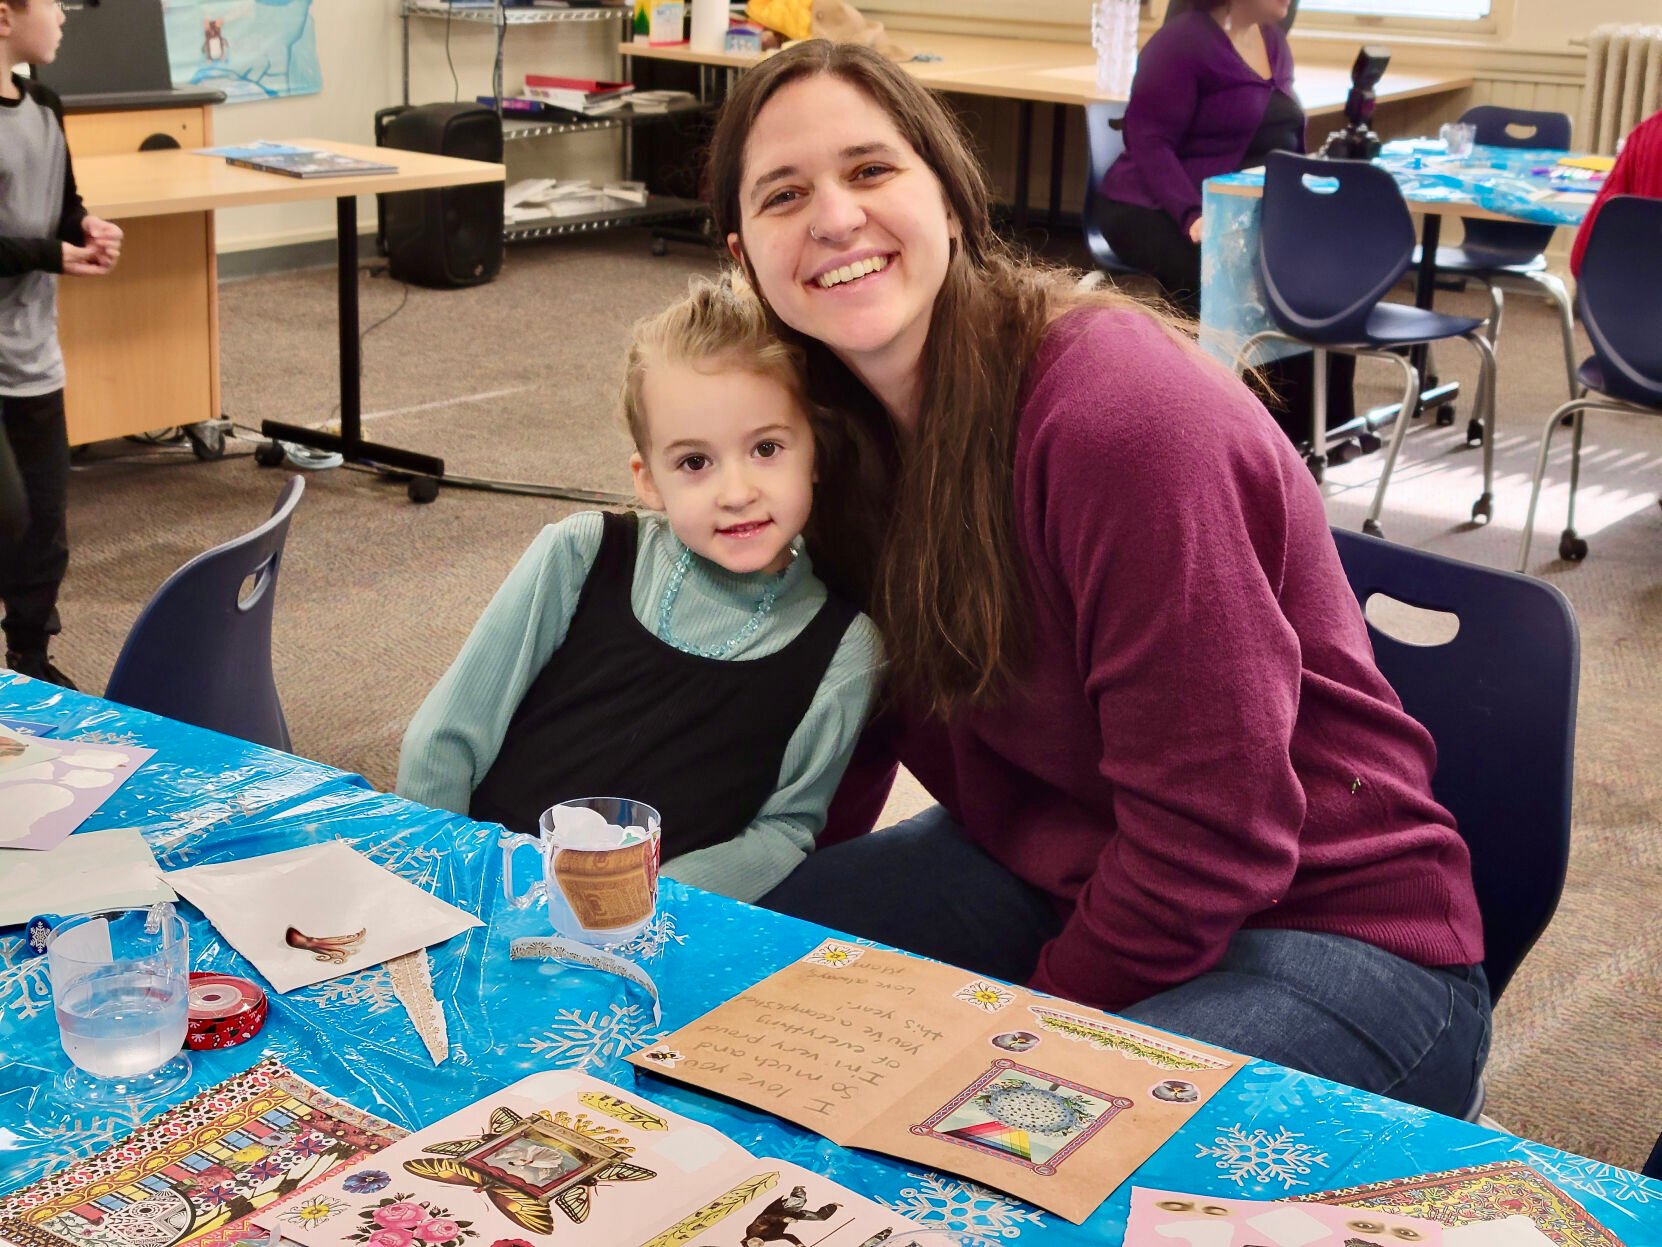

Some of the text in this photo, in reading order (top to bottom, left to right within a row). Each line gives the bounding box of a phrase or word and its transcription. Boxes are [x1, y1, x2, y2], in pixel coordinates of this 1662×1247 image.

[852, 961, 905, 976] Mom
[875, 980, 916, 996] Love
[756, 1014, 901, 1069] of everything
[903, 1019, 944, 1041] this
[693, 1041, 746, 1057] and
[700, 1024, 885, 1086] I'm very proud
[754, 1055, 823, 1081] much
[684, 1059, 835, 1115] I love you
